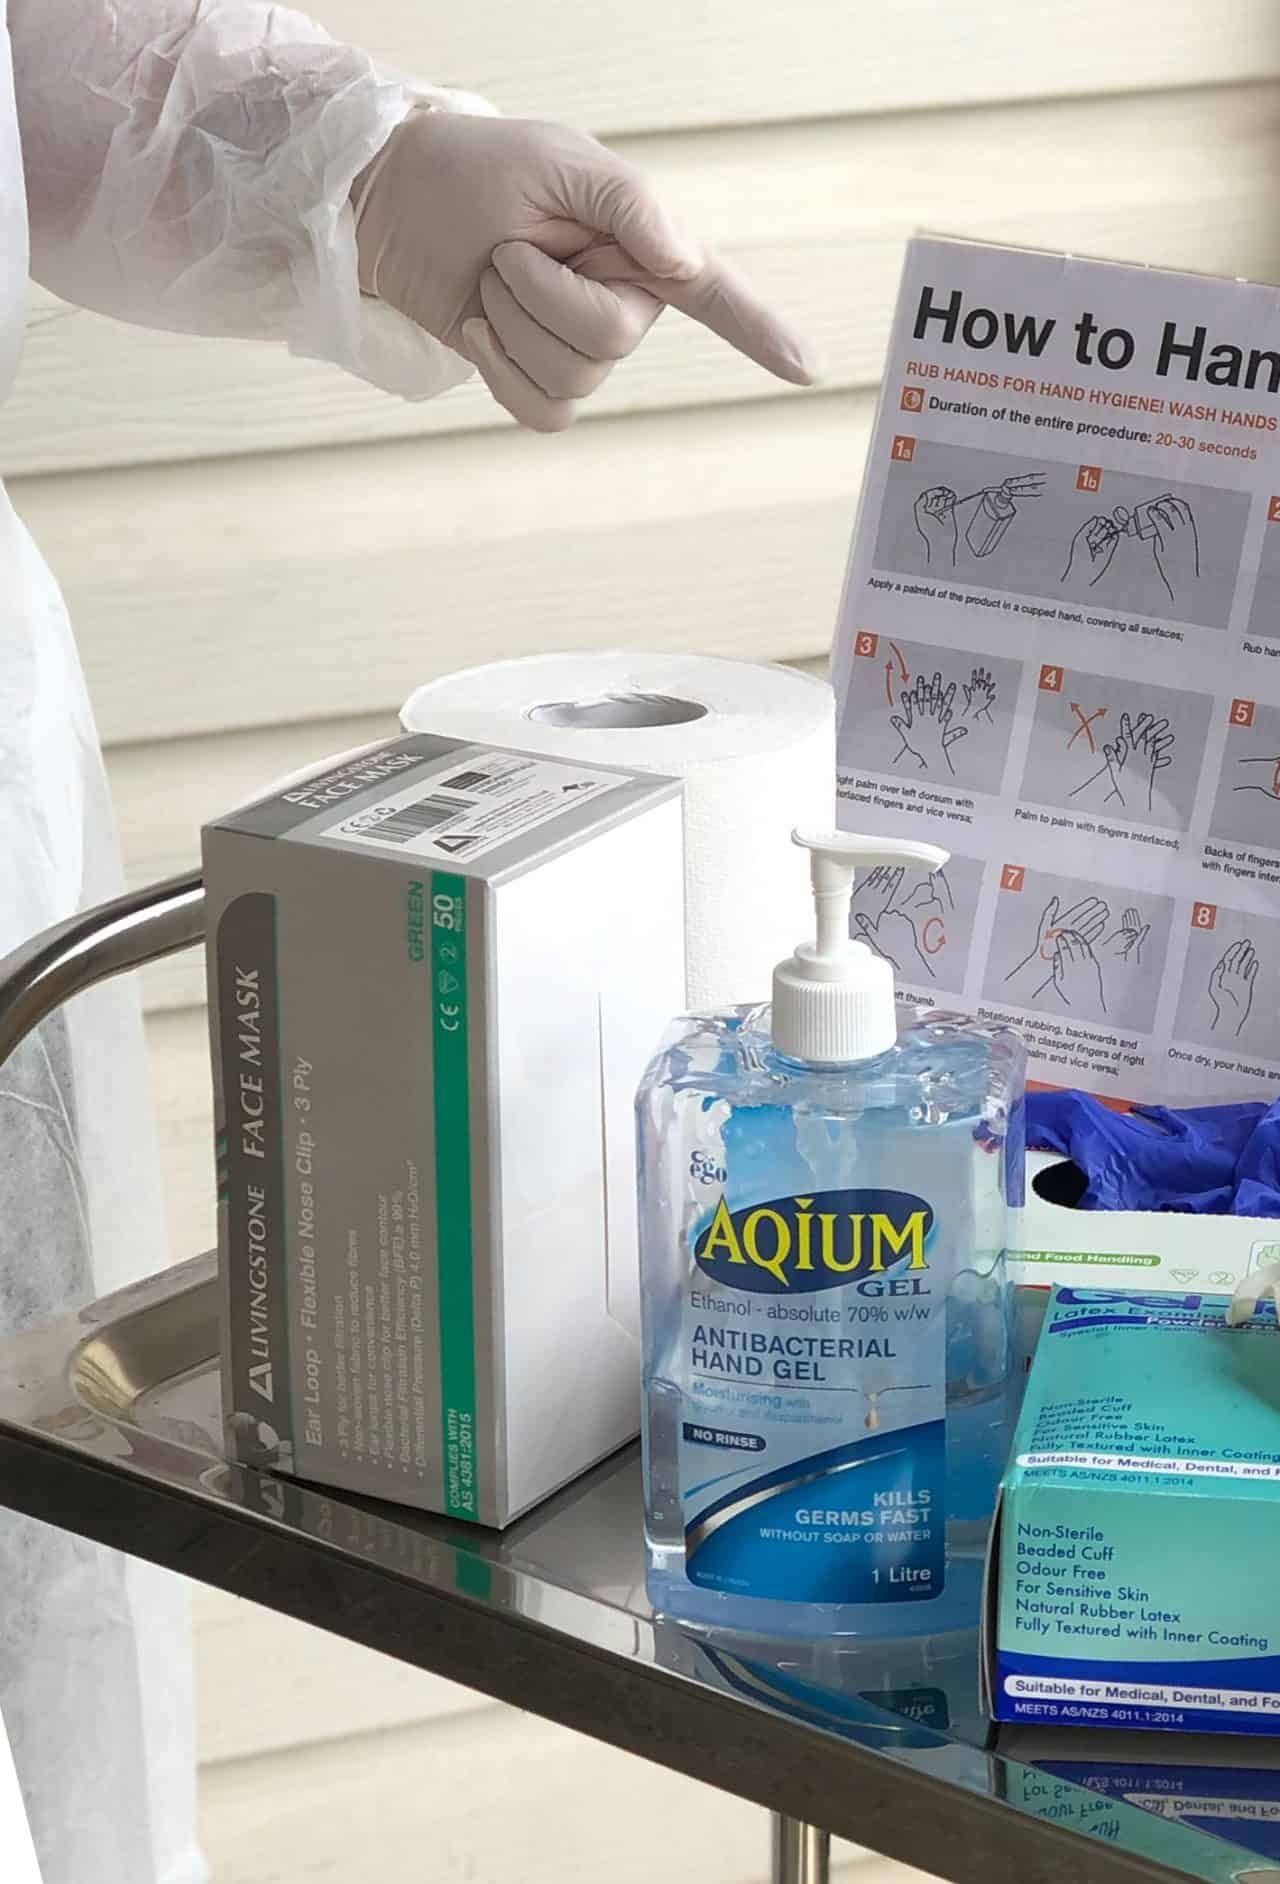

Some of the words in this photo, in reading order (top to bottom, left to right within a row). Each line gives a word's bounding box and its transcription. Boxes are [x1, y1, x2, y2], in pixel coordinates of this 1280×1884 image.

[914, 287, 1054, 355] How
[1075, 313, 1134, 369] to
[906, 361, 939, 378] RUB
[943, 367, 998, 387] HANDS
[1003, 375, 1035, 393] FOR
[1039, 382, 1084, 400] HAND
[1089, 390, 1164, 413] HYGIENE!
[1169, 401, 1216, 421] WASH
[1221, 409, 1277, 430] HANDS
[929, 396, 987, 416] Duration
[991, 407, 1006, 419] of
[1009, 409, 1030, 424] the
[1034, 416, 1073, 430] entire
[1076, 423, 1151, 442] procedure:
[1155, 432, 1195, 449] 20-30
[1198, 442, 1256, 459] seconds
[861, 637, 872, 654] 3
[1242, 642, 1262, 654] Rub
[1044, 670, 1057, 687] 4
[1234, 704, 1248, 722] 5
[1201, 861, 1221, 870] with
[1223, 863, 1255, 877] fingers
[1204, 845, 1233, 859] Backs
[1235, 852, 1246, 861] of
[1247, 854, 1280, 868] fingers
[1008, 869, 1019, 886] 7
[408, 880, 424, 963] GREEN
[433, 894, 454, 930] 50
[1198, 907, 1210, 925] 8
[236, 967, 260, 1065] MASK
[977, 1007, 1023, 1024] Rotational
[1024, 1020, 1062, 1035] rubbing,
[1065, 1027, 1116, 1045] backwards
[1119, 1039, 1137, 1049] and
[293, 1056, 312, 1090] Ply
[1167, 1047, 1192, 1061] Once
[1194, 1055, 1210, 1066] dry,
[1213, 1059, 1234, 1070] your
[1236, 1063, 1265, 1077] hands
[240, 1074, 264, 1157] FACE
[294, 1097, 310, 1111] 3
[295, 1132, 315, 1174] Clip
[298, 1182, 313, 1238] Nose
[247, 1186, 268, 1356] LIVINGSTONE
[1045, 1252, 1083, 1262] Food
[1087, 1254, 1152, 1266] Handling
[299, 1245, 316, 1328] Flexible
[856, 1278, 931, 1298] GEL
[691, 1291, 750, 1316] Ethanol
[767, 1303, 841, 1322] absolute
[847, 1305, 889, 1322] 70%
[895, 1305, 930, 1321] w/w
[692, 1324, 896, 1358] ANTIBACTERIAL
[303, 1349, 321, 1402] Loop
[692, 1347, 763, 1376] HAND
[773, 1360, 826, 1382] GEL
[305, 1408, 321, 1445] Ear
[447, 1408, 457, 1440] WITH
[459, 1413, 472, 1486] 4381:2015
[693, 1428, 713, 1442] NO
[716, 1432, 758, 1449] RINSE
[447, 1443, 460, 1507] COMPLIES
[1027, 1455, 1088, 1464] Suitable
[1091, 1457, 1114, 1466] for
[1116, 1459, 1180, 1471] Medical,
[1184, 1463, 1238, 1475] Dental,
[1242, 1467, 1270, 1475] and
[461, 1490, 472, 1511] AS
[873, 1489, 931, 1507] KILLS
[795, 1509, 875, 1526] GERMS
[881, 1508, 931, 1524] FAST
[759, 1527, 820, 1544] WITHOUT
[824, 1531, 860, 1544] SOAP
[864, 1531, 883, 1544] OR
[885, 1528, 931, 1544] WATER
[1017, 1523, 1104, 1542] Non-Sterile
[1017, 1542, 1075, 1558] Beaded
[1081, 1546, 1112, 1560] Cuff
[871, 1569, 880, 1584] 1
[889, 1567, 931, 1583] Litre
[1016, 1560, 1066, 1576] Odour
[1073, 1564, 1105, 1579] Free
[1016, 1579, 1040, 1593] For
[1046, 1581, 1111, 1598] Sensitive
[1117, 1586, 1148, 1600] Skin
[1016, 1598, 1073, 1614] Natural
[1080, 1603, 1134, 1619] Rubber
[1140, 1607, 1179, 1622] Latex
[1015, 1616, 1049, 1634] Fully
[1056, 1620, 1120, 1637] Textured
[1126, 1625, 1157, 1639] with
[1163, 1628, 1202, 1642] Inner
[1207, 1631, 1267, 1650] Coating
[1015, 1679, 1075, 1694] Suitable
[1079, 1685, 1100, 1696] for
[1105, 1686, 1167, 1702] Medical,
[1172, 1690, 1224, 1705] Dental,
[1229, 1696, 1257, 1706] and
[1014, 1703, 1057, 1715] MEETS
[1060, 1706, 1108, 1718] AS/NZS
[1111, 1709, 1183, 1722] 4011.1:2014
